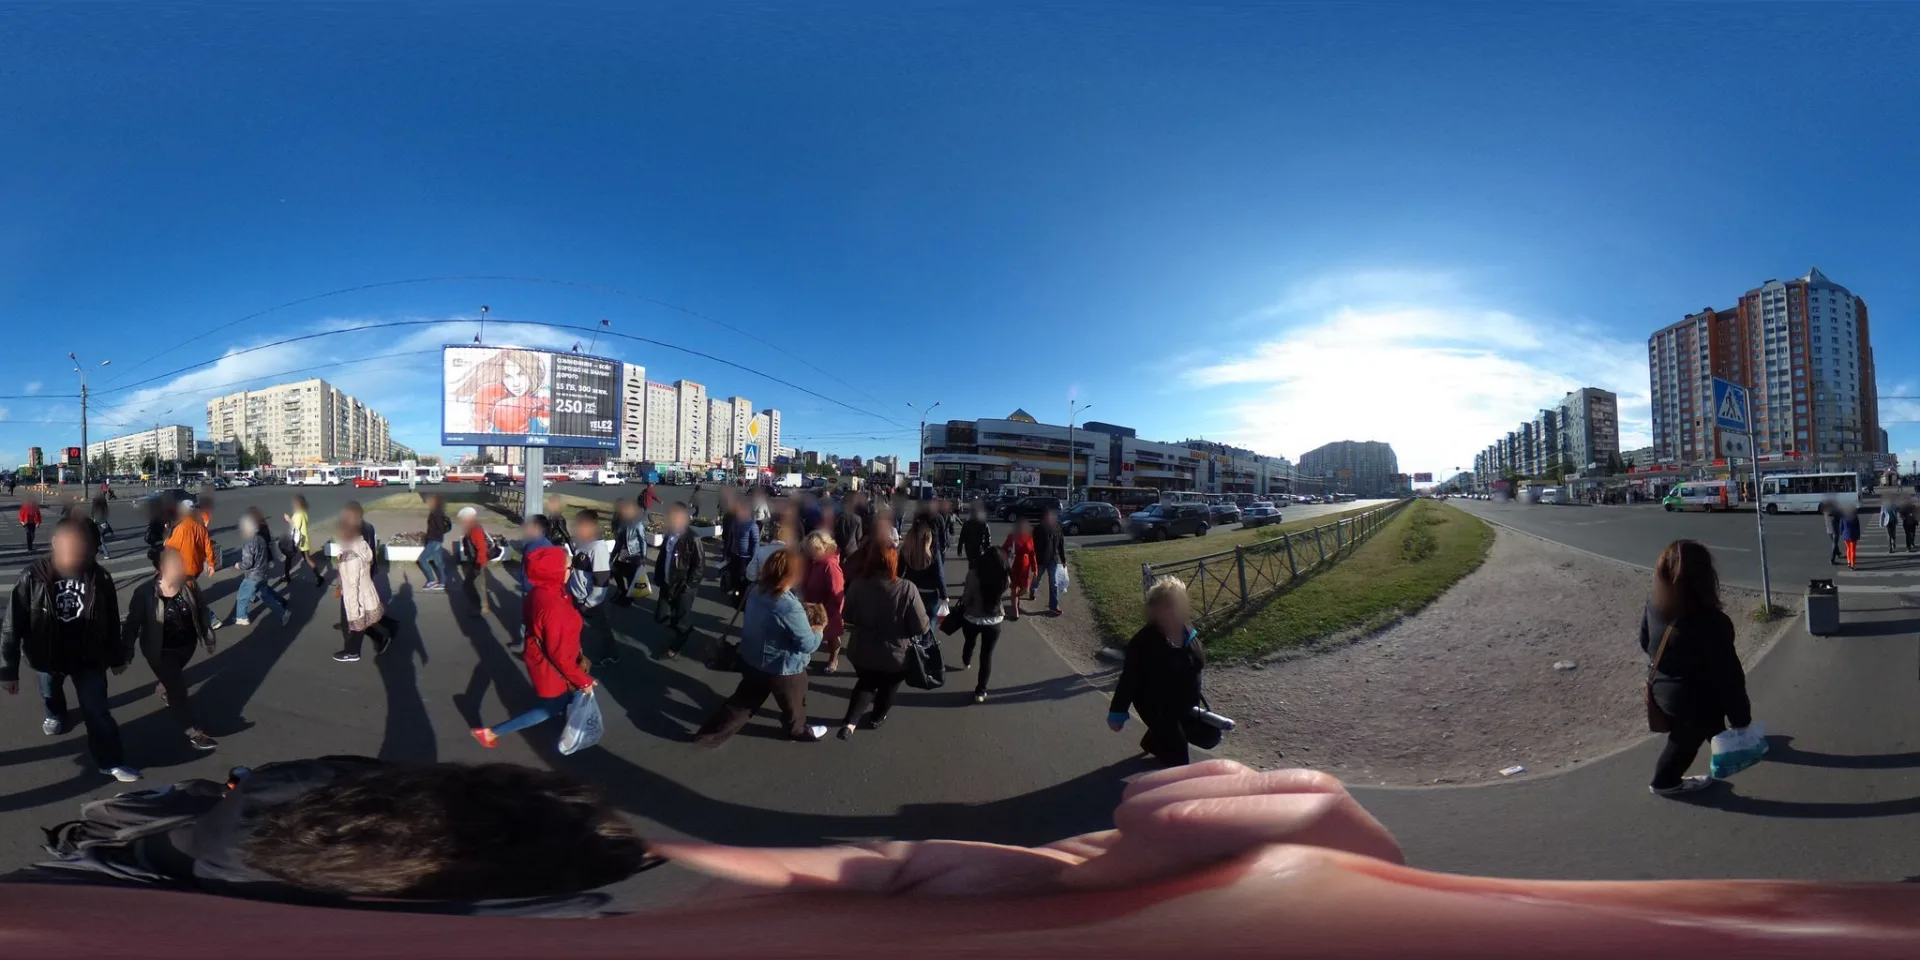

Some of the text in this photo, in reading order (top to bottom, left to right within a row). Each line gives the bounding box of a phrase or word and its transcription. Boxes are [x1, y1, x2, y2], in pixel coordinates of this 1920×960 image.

[556, 365, 581, 373] ХОРОШО
[578, 385, 591, 393] 300
[556, 399, 582, 414] 250
[590, 420, 613, 430] TELE2
